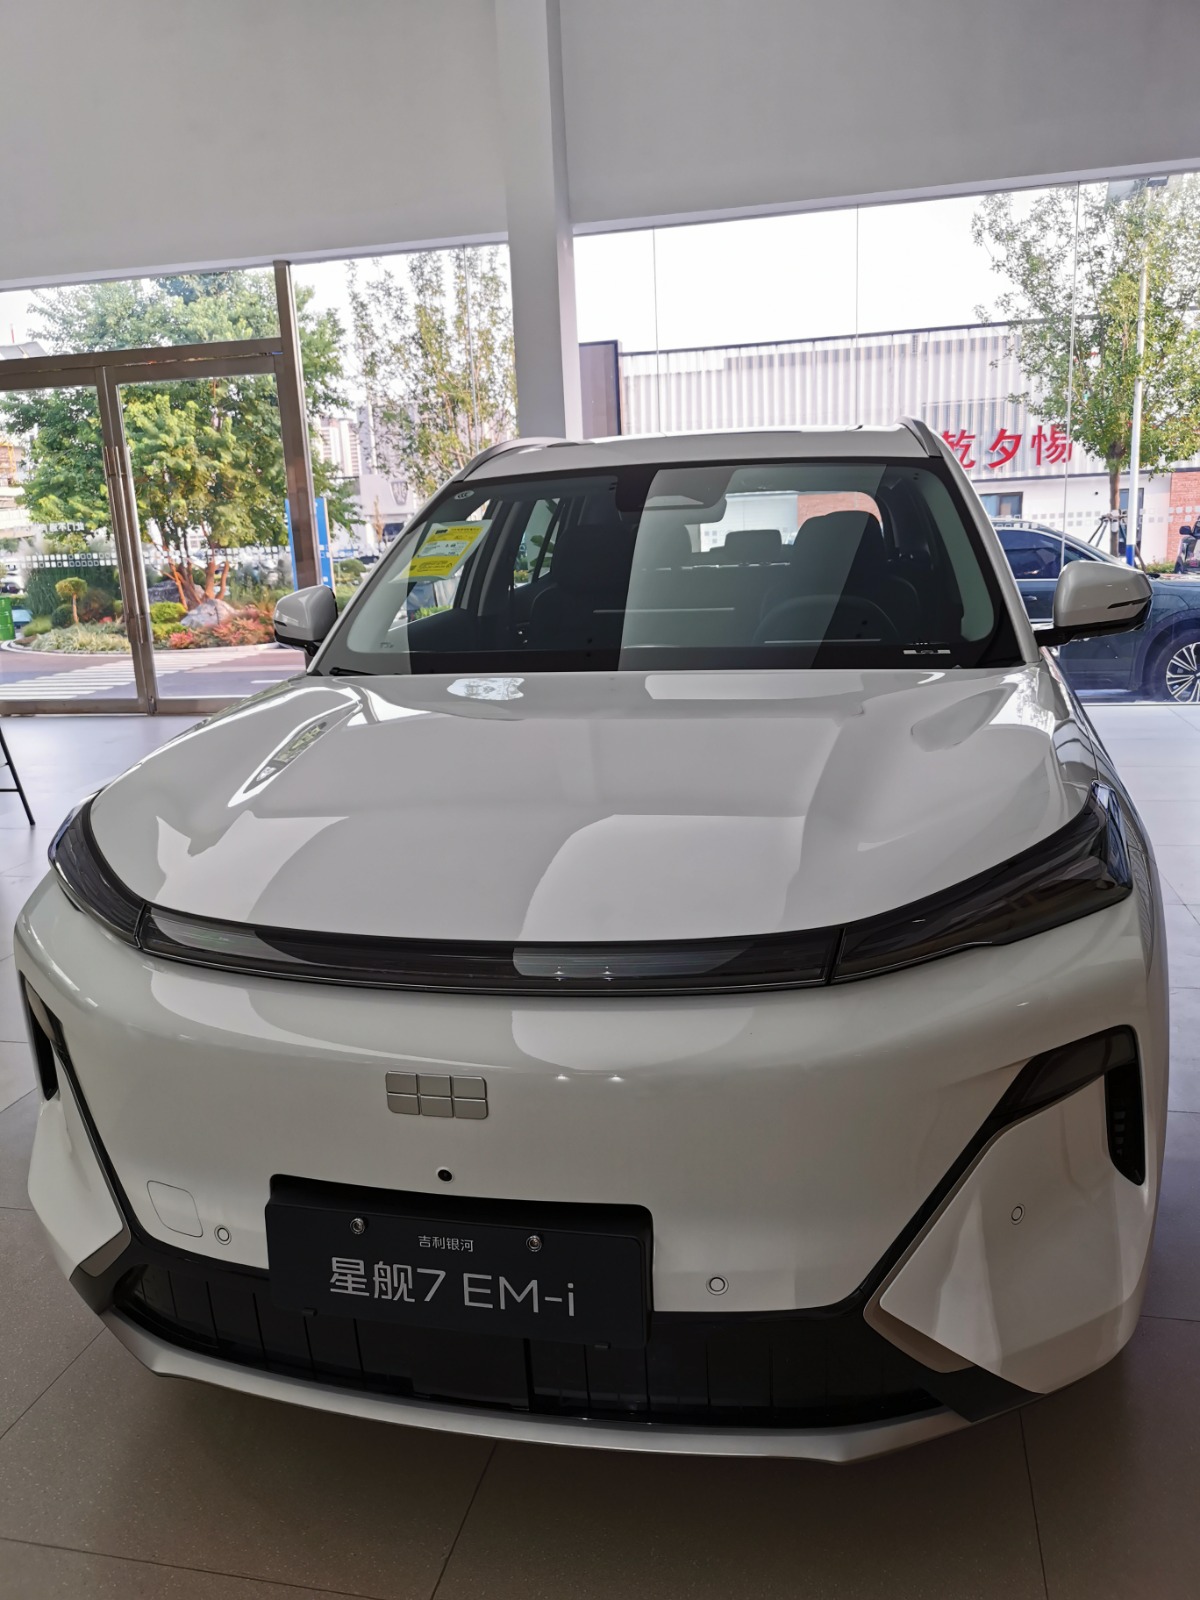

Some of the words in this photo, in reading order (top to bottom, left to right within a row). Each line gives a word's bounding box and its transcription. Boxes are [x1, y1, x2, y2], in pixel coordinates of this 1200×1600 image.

[417, 1235, 474, 1253] 吉利银河
[329, 1257, 447, 1303] 星舰7
[462, 1272, 575, 1317] EM-i
